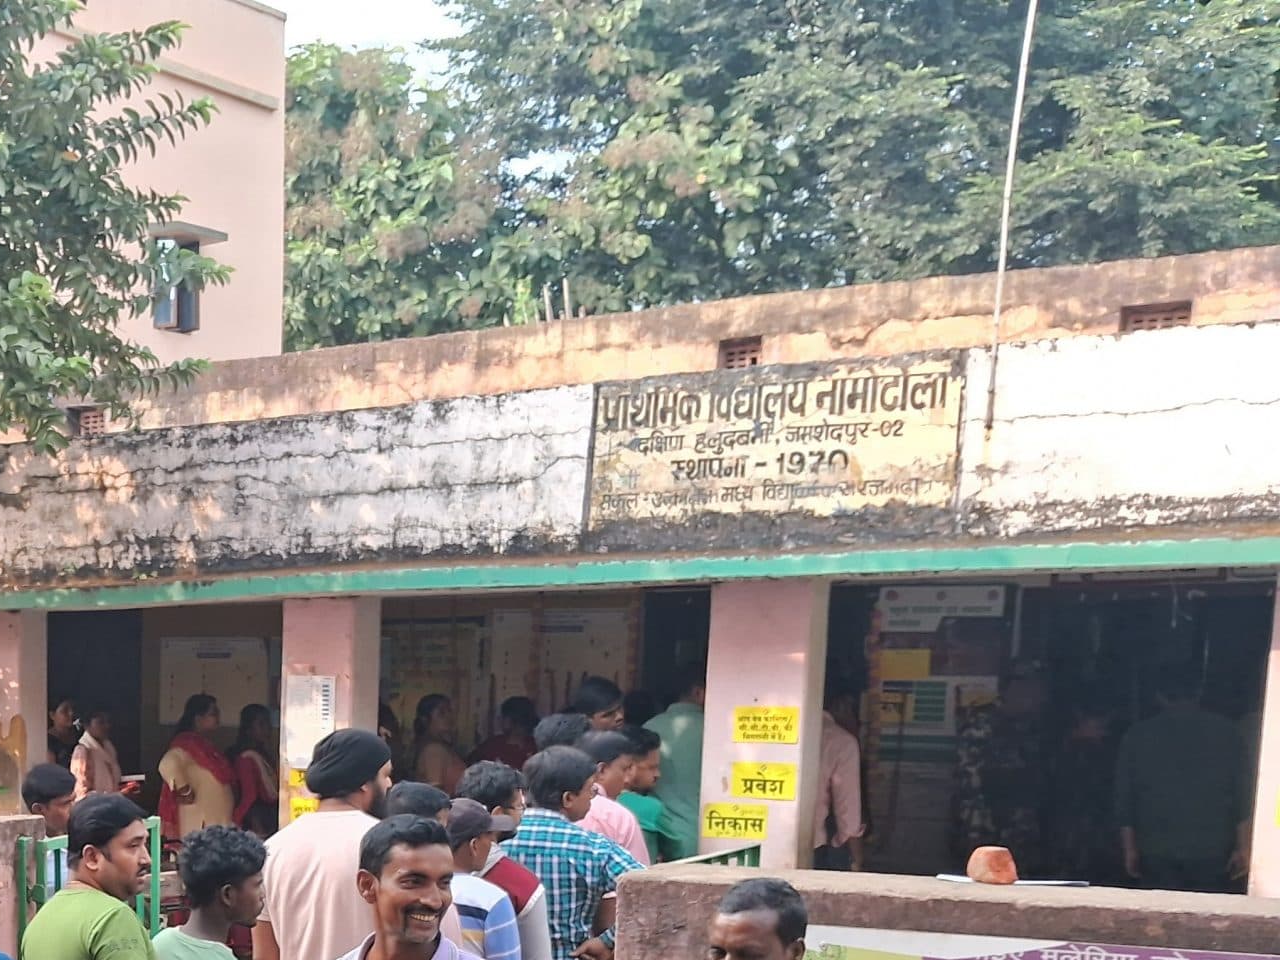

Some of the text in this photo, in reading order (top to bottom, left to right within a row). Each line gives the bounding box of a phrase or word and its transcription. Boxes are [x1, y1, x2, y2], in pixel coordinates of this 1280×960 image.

[776, 449, 849, 476] 1970
[741, 771, 784, 794] प्रवेश
[706, 810, 764, 833] निकास
